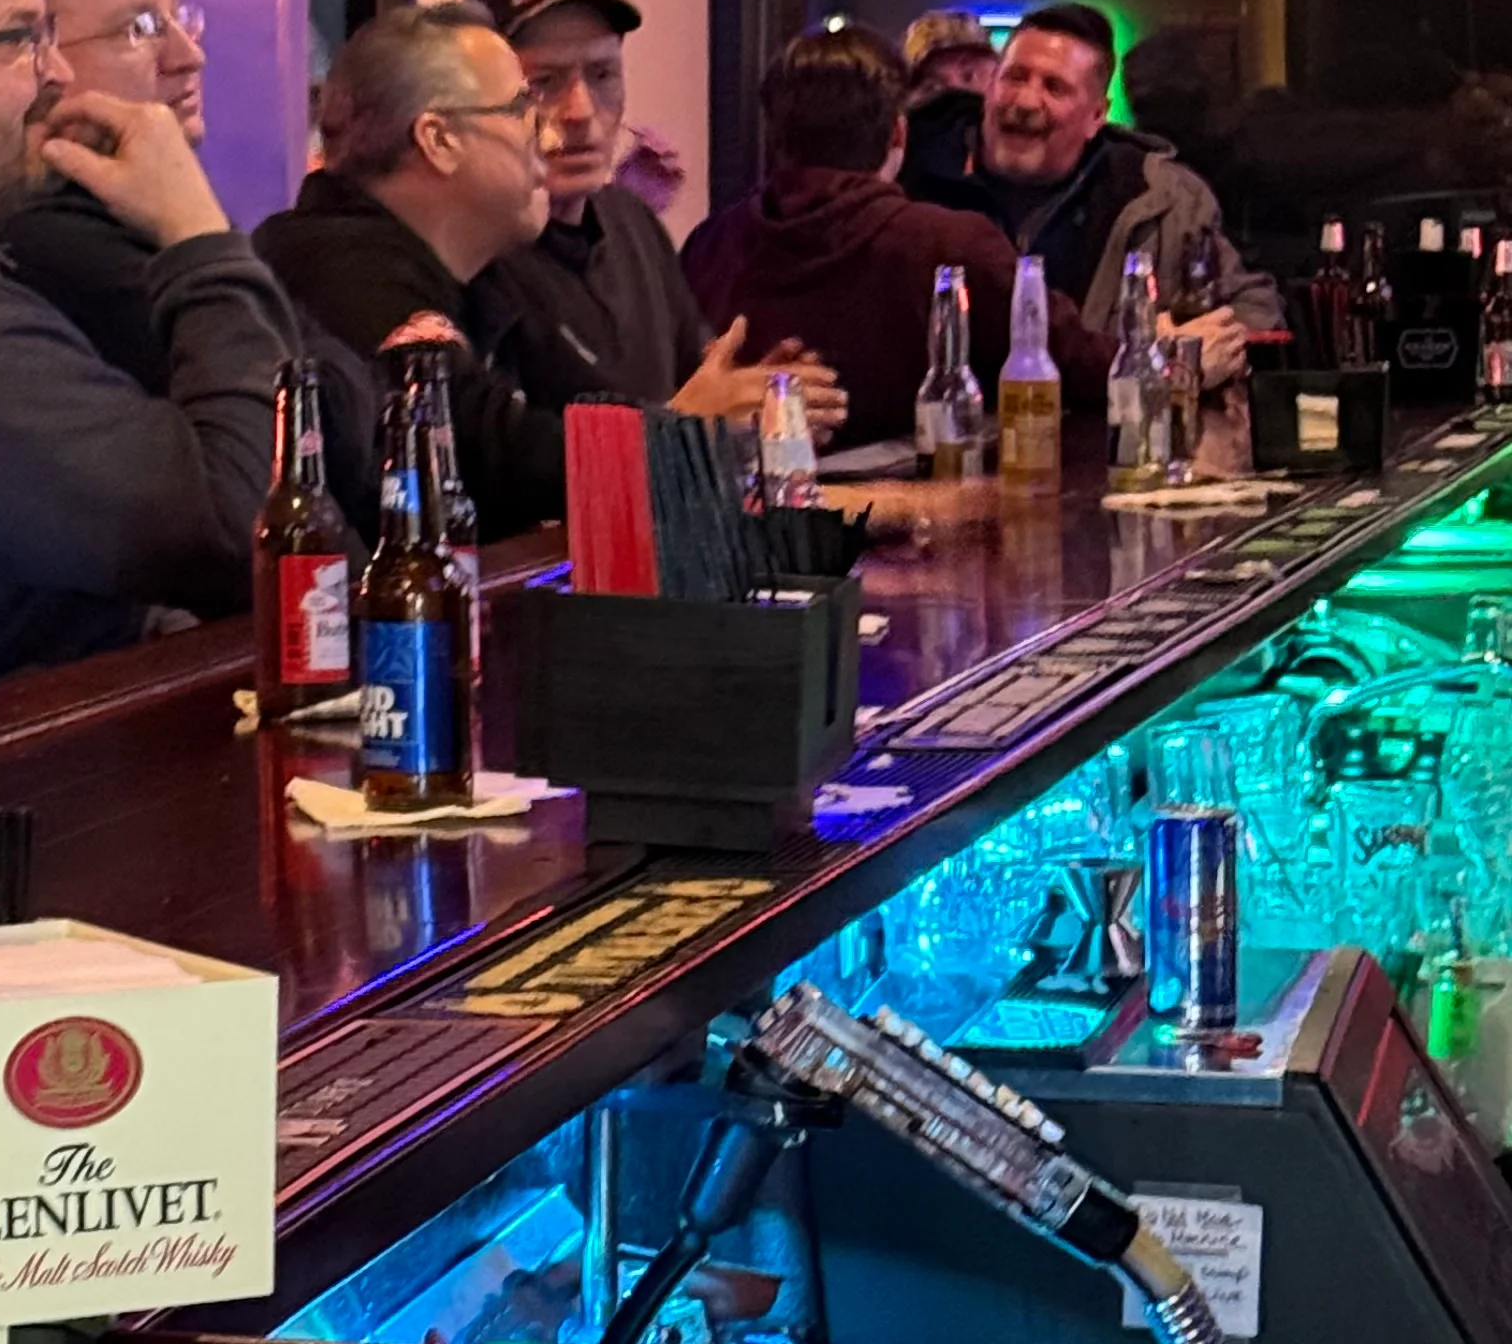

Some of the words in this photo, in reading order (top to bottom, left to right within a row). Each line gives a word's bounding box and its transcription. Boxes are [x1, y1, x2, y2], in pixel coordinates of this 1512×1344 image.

[38, 1142, 117, 1187] The
[0, 1247, 71, 1292] Malt
[68, 1240, 151, 1284] Scotch
[148, 1232, 240, 1280] Whisky
